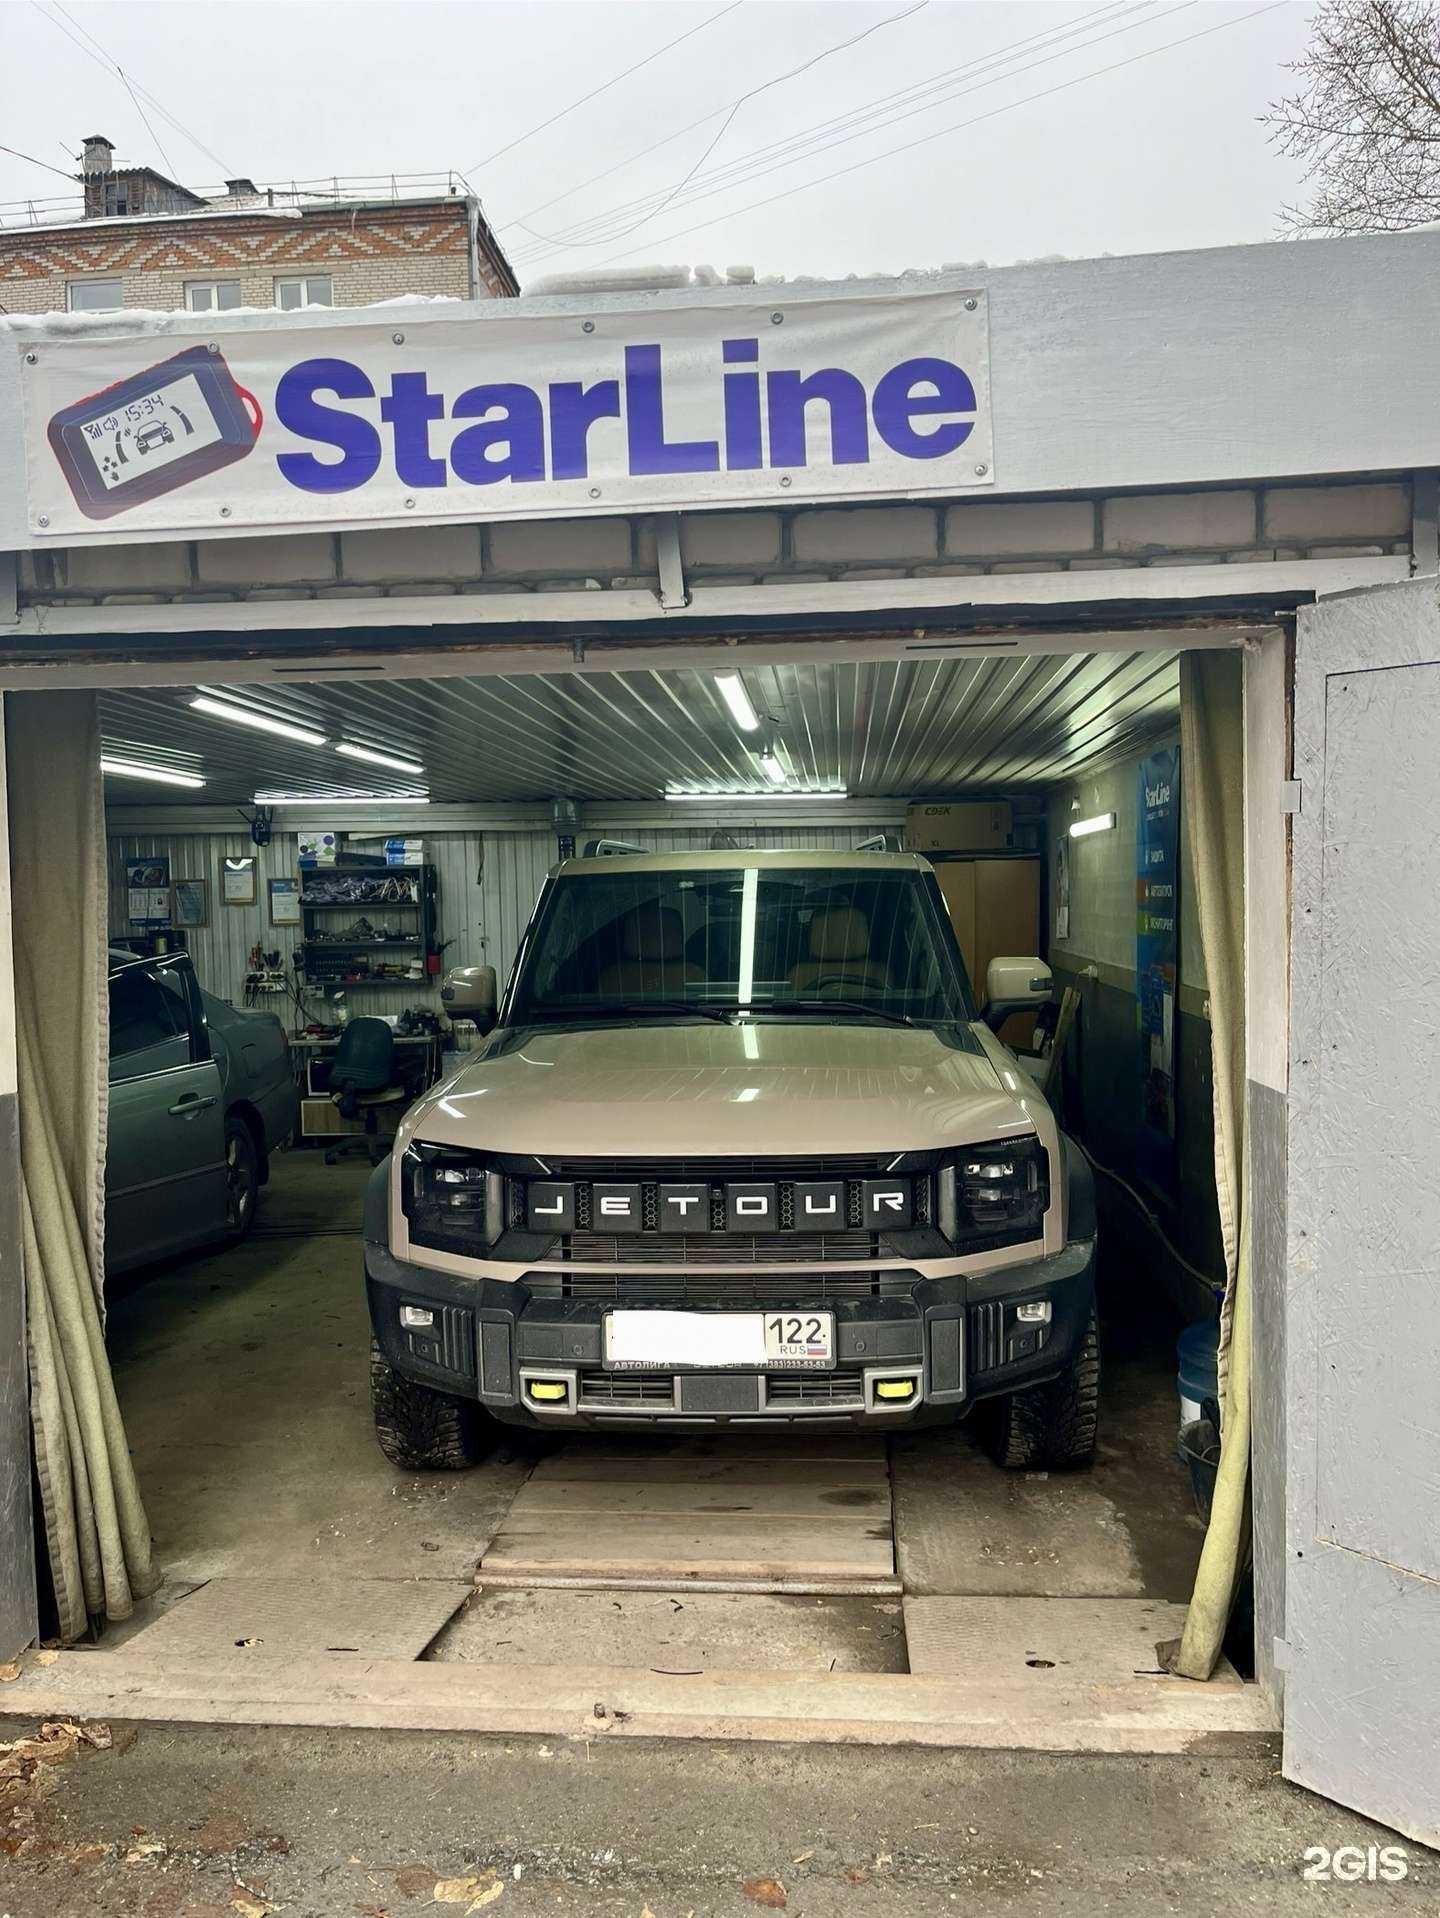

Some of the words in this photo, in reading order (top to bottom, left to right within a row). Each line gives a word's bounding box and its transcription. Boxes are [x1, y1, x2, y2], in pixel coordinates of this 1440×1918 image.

[124, 394, 164, 422] 15:34
[276, 338, 977, 494] StarLine
[924, 806, 951, 816] CDEK
[534, 1191, 904, 1216] JETOUR
[768, 1317, 823, 1344] 122
[780, 1345, 807, 1355] RUS
